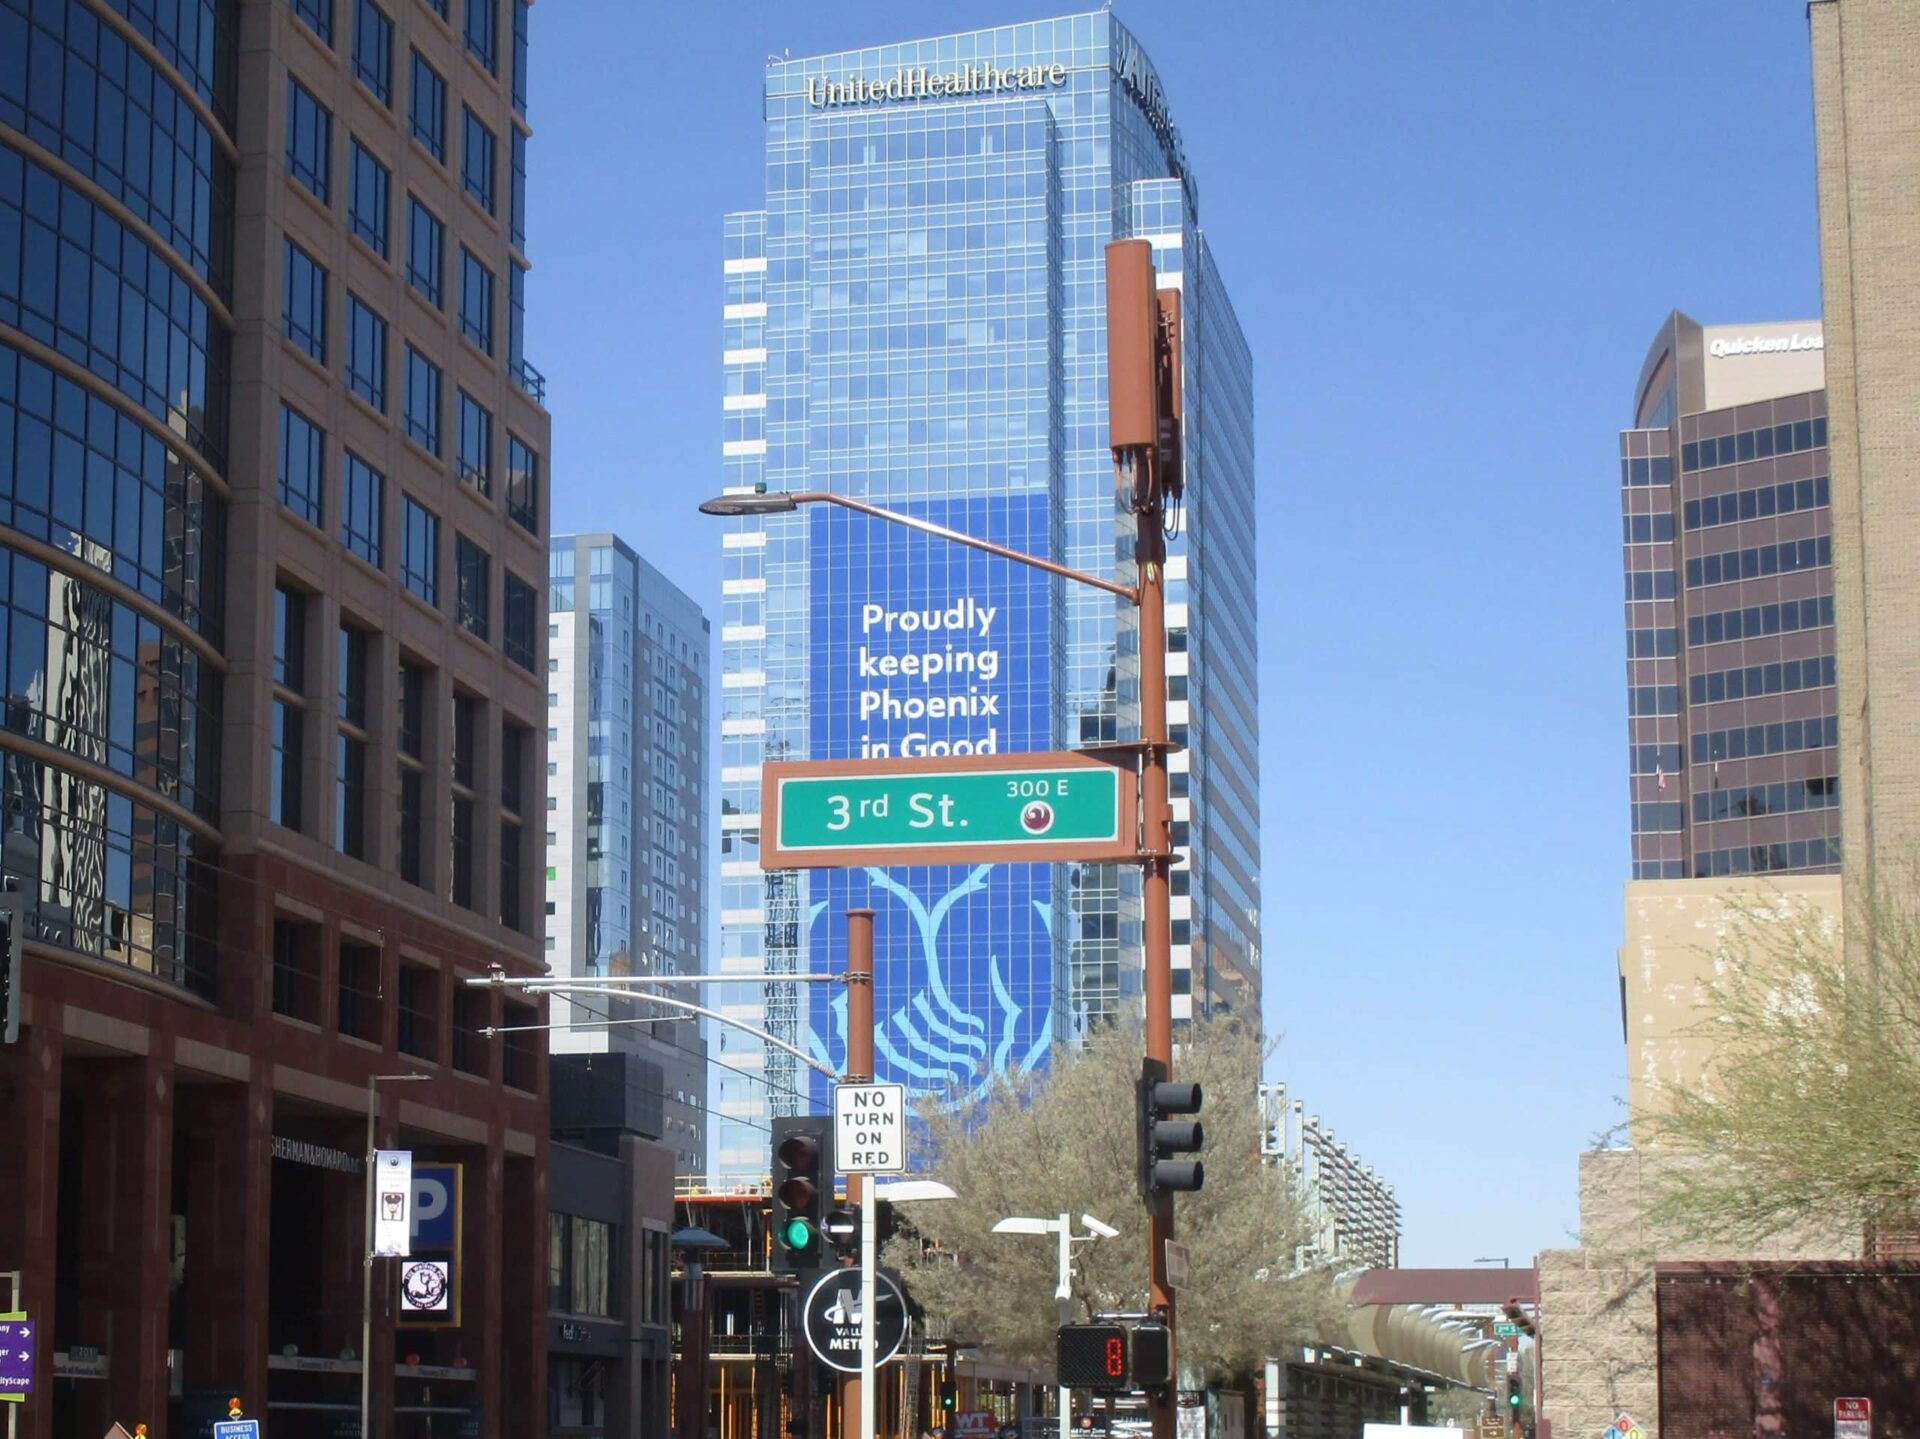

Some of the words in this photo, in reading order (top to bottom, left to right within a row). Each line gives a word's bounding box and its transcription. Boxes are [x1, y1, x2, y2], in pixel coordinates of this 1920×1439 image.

[807, 61, 1066, 107] UnitedHealthcare
[1709, 337, 1785, 358] Quicken
[1786, 333, 1823, 350] Loa
[862, 598, 997, 636] Proudly
[860, 643, 999, 683] keeping
[860, 686, 1000, 721] Phoenix
[861, 735, 889, 759] in
[900, 728, 997, 759] Good
[1007, 780, 1049, 798] 300
[1056, 779, 1069, 796] E
[826, 793, 889, 830] 3rd
[908, 792, 968, 828] St.
[854, 1091, 885, 1108] NO
[842, 1112, 893, 1126] TURN
[856, 1131, 881, 1145] ON
[852, 1151, 889, 1165] RED
[836, 1327, 863, 1336] VALL
[829, 1338, 880, 1351] MET
[1106, 1338, 1122, 1376] 8
[1845, 1401, 1859, 1410] NO
[220, 1424, 252, 1434] BUSINESS
